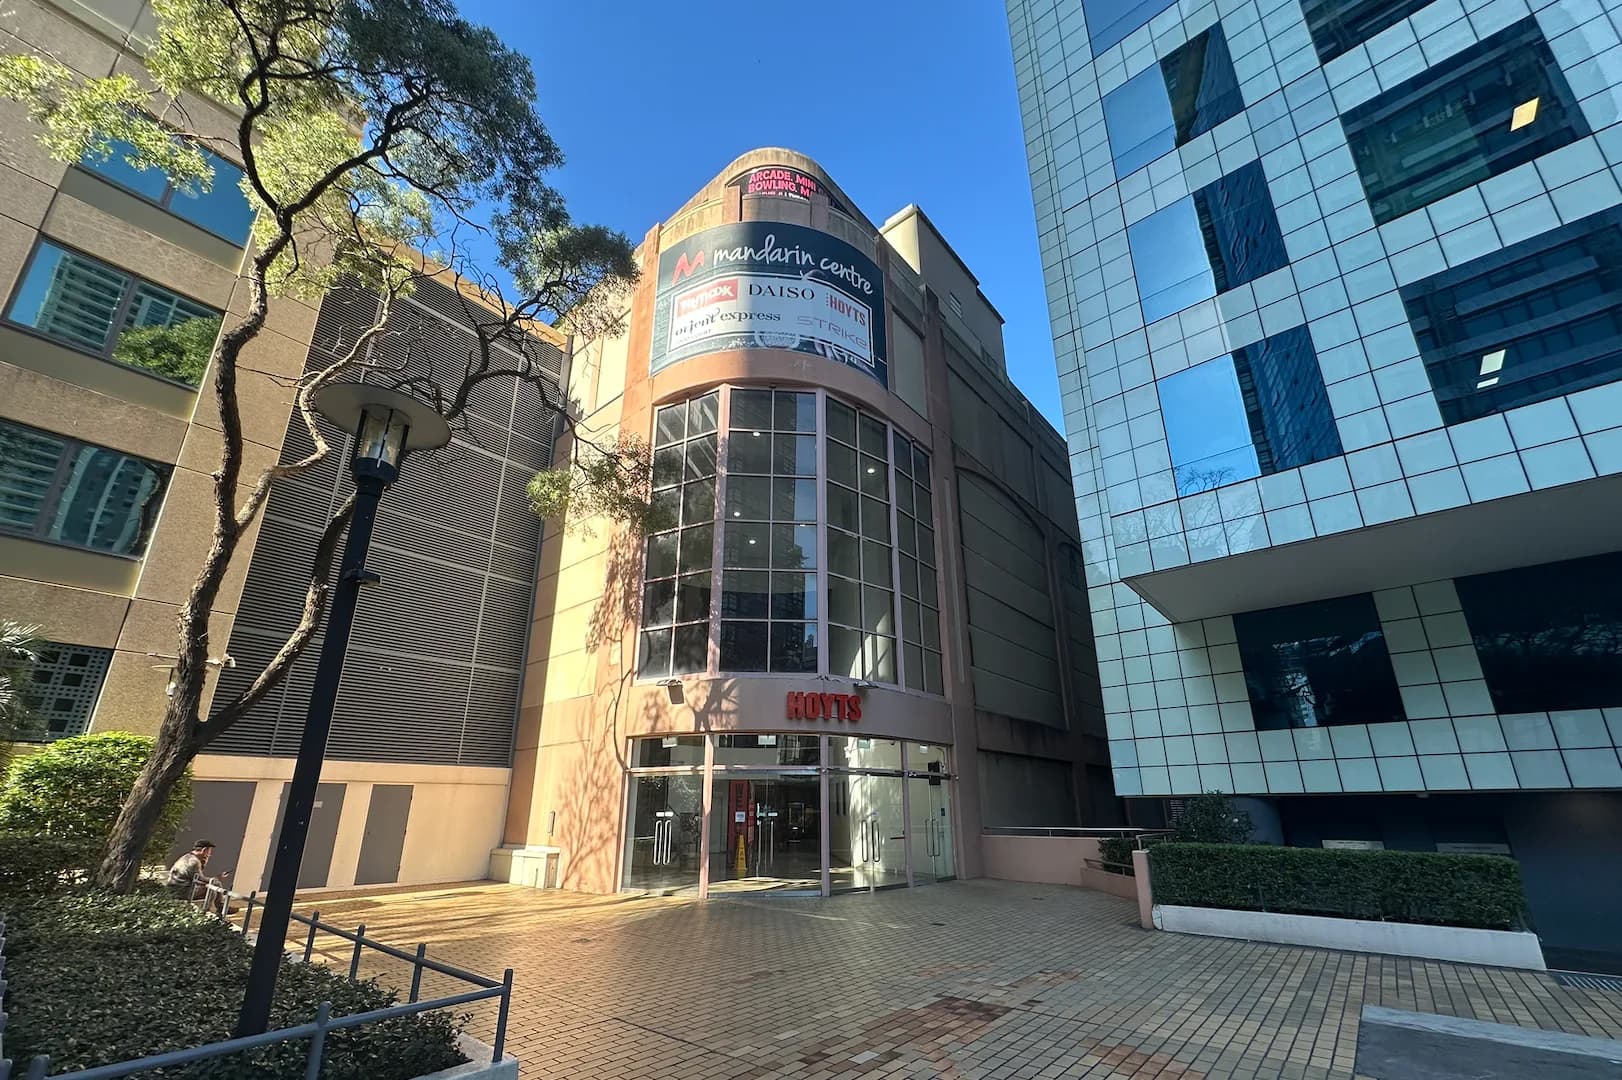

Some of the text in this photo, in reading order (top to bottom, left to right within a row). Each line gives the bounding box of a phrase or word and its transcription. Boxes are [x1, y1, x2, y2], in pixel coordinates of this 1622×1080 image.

[748, 180, 798, 193] BOWLING.
[749, 170, 793, 183] ARCADE.
[713, 234, 816, 265] mandarin
[820, 257, 874, 295] centre
[749, 283, 815, 301] DAISO
[720, 311, 781, 322] express
[829, 294, 866, 327] HOYTS
[796, 315, 868, 349] STRIKE
[786, 691, 862, 721] HOYTS
